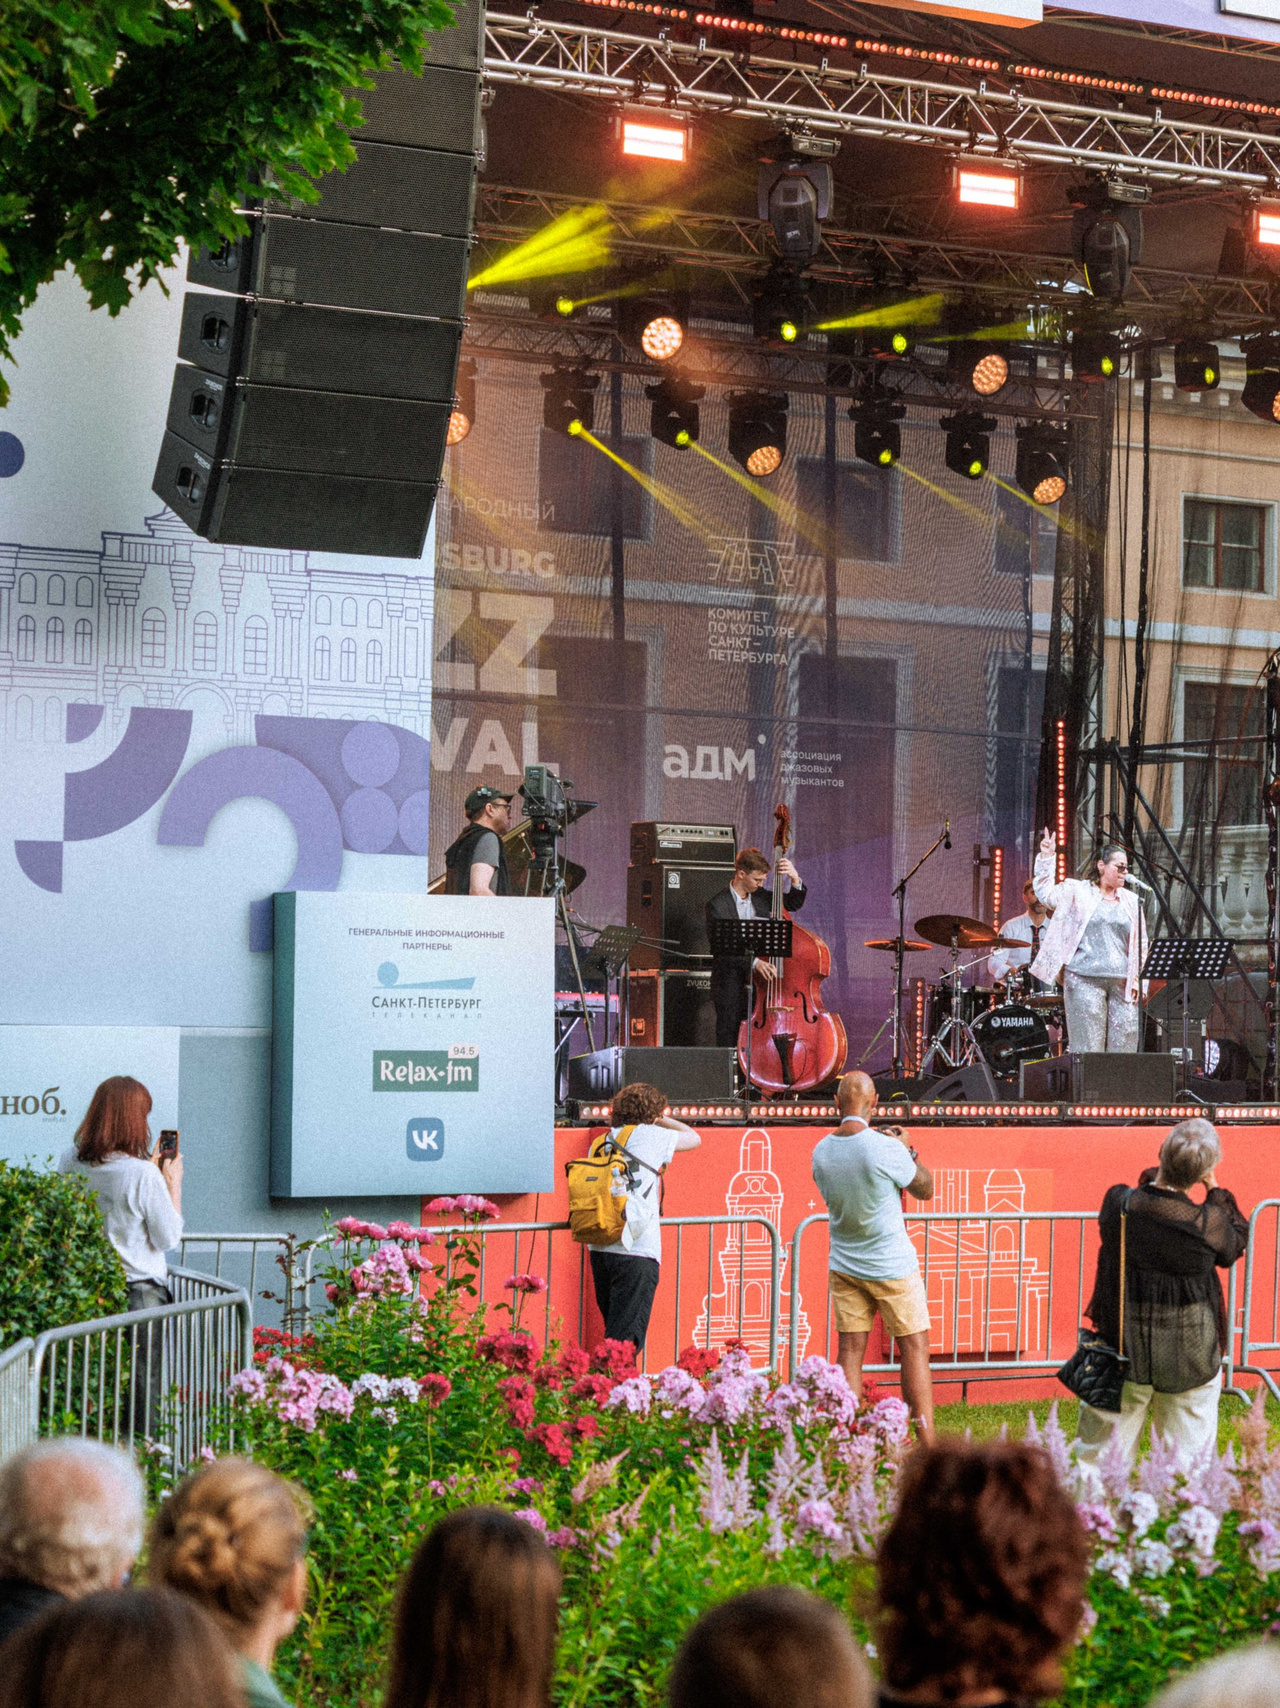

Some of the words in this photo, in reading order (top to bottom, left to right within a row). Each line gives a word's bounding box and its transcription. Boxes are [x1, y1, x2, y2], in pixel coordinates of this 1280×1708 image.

[708, 607, 768, 622] КОМИТЕТ
[708, 621, 727, 633] ПО
[730, 624, 795, 639] КУЛЬТУРЕ
[708, 649, 788, 666] ПЕТЕРБУРГА
[780, 749, 842, 762] ассоциация
[780, 763, 833, 775] джазовых
[780, 777, 845, 789] музыкантов
[348, 928, 413, 937] ГЕНЕРАЛЬНЫЕ
[415, 930, 505, 939] ИНФОРМАЦИОННЫЕ
[402, 942, 453, 951] ПАРТНЕРЫ:
[1001, 1017, 1034, 1027] YAMAHA
[453, 1046, 475, 1056] 94.5
